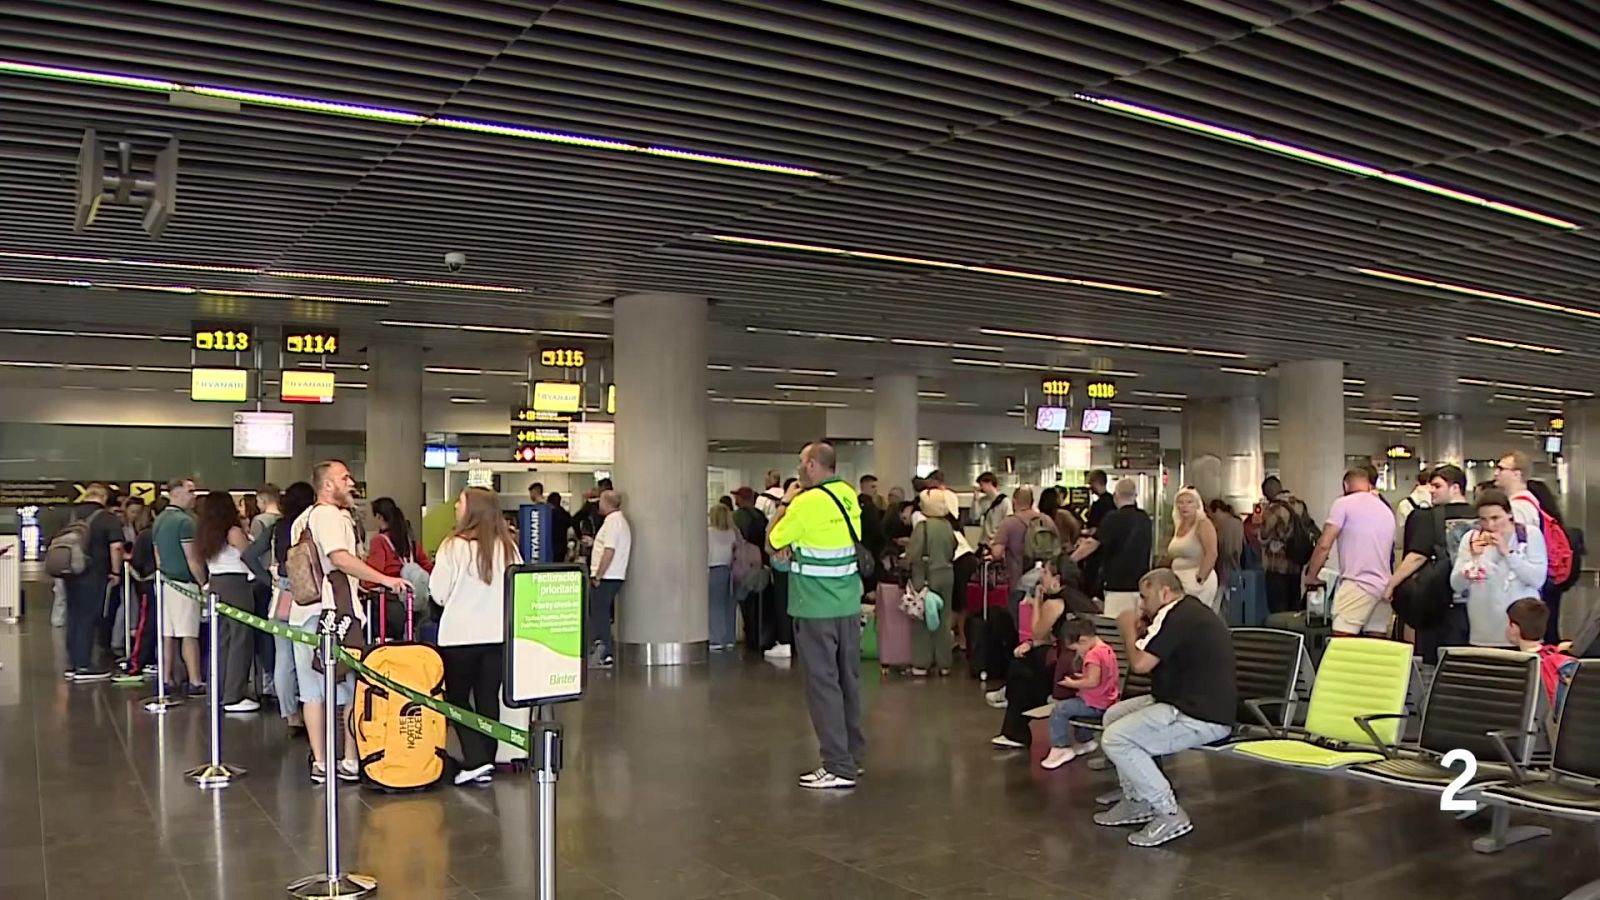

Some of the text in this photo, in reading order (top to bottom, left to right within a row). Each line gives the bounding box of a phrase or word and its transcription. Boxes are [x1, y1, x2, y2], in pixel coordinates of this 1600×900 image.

[214, 331, 249, 350] 113
[304, 334, 337, 353] 114
[556, 349, 584, 367] 115
[1052, 380, 1070, 395] 117
[531, 510, 540, 558] RYANAIR
[540, 583, 580, 596] prioritaria
[549, 673, 577, 685] Binter
[399, 716, 407, 735] THE
[407, 716, 415, 749] NORTH
[414, 716, 423, 739] FACE
